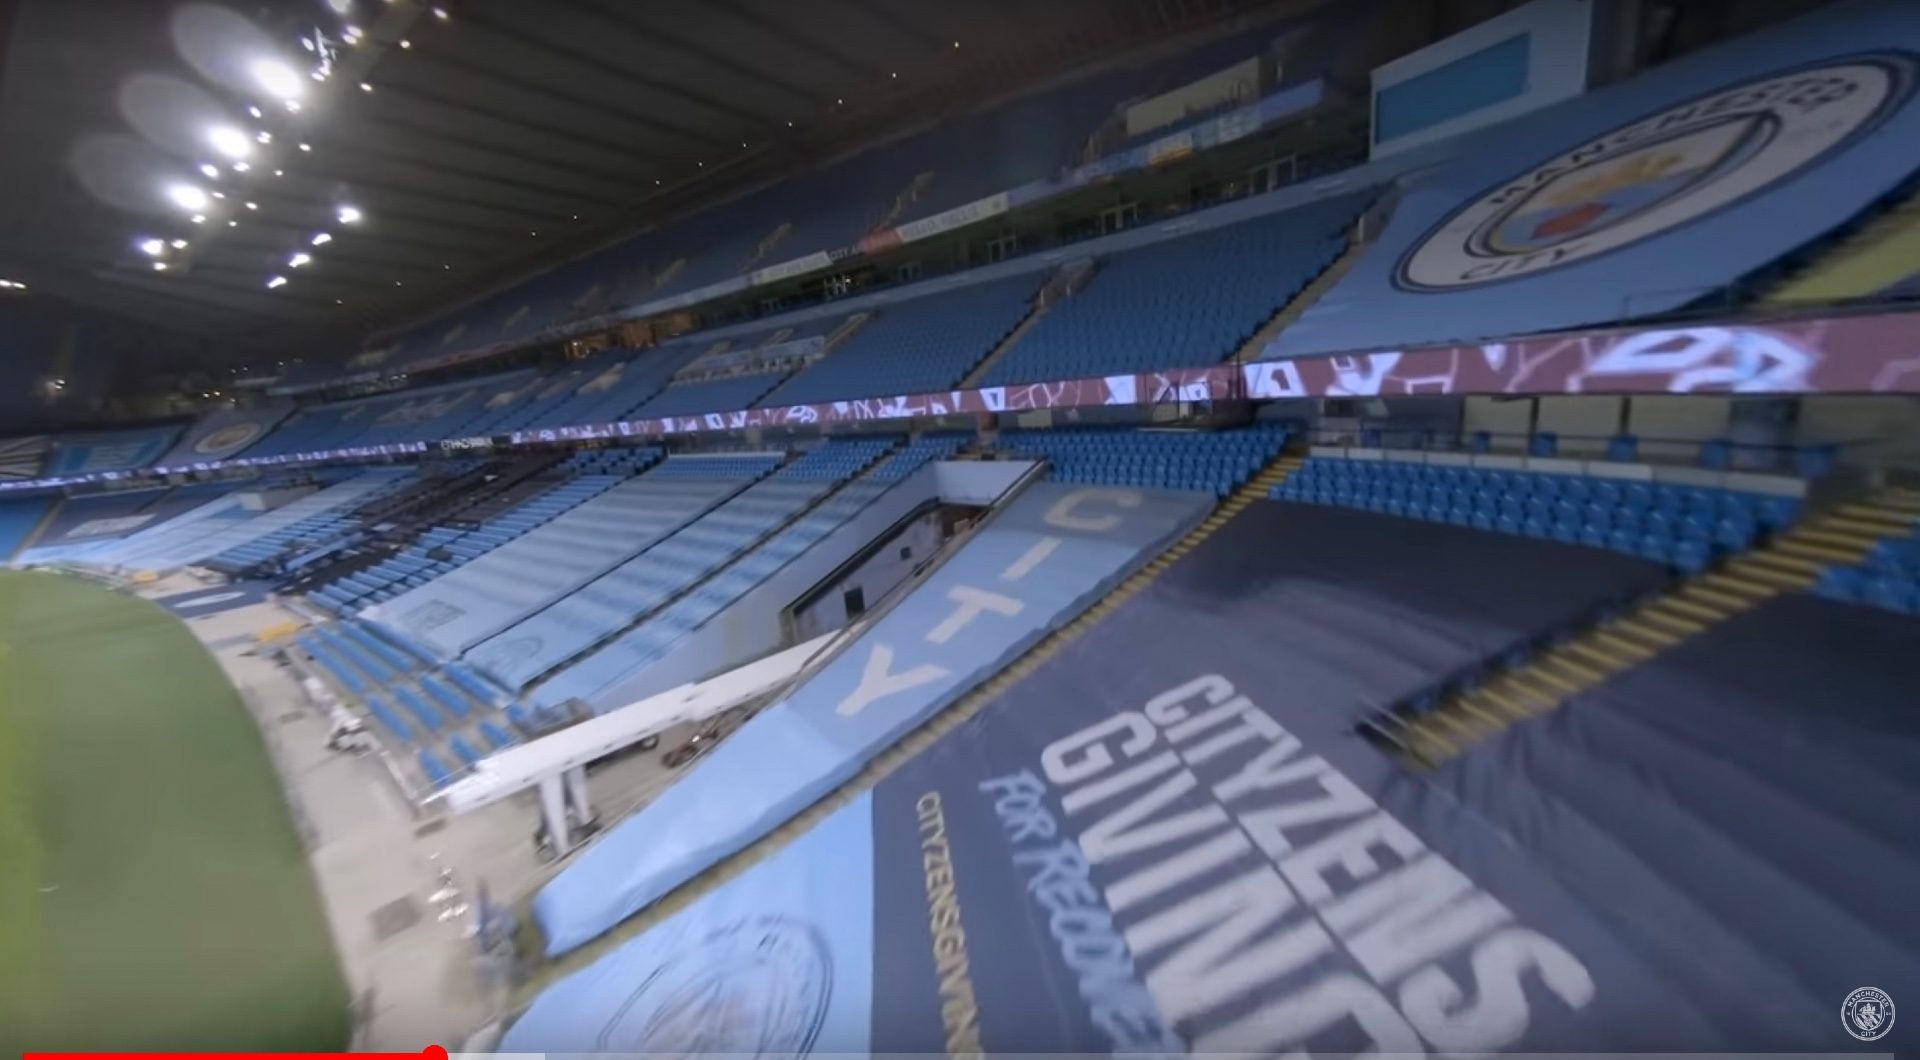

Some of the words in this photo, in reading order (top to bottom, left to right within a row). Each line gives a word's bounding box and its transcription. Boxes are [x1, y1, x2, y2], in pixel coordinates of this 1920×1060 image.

[1460, 243, 1592, 280] CITY
[835, 488, 1143, 718] CITY
[979, 769, 1057, 843] FOR
[1145, 674, 1597, 1056] CITYZENS
[917, 791, 985, 1060] CITYZENSGIVIN
[1012, 838, 1192, 1060] RECOVE
